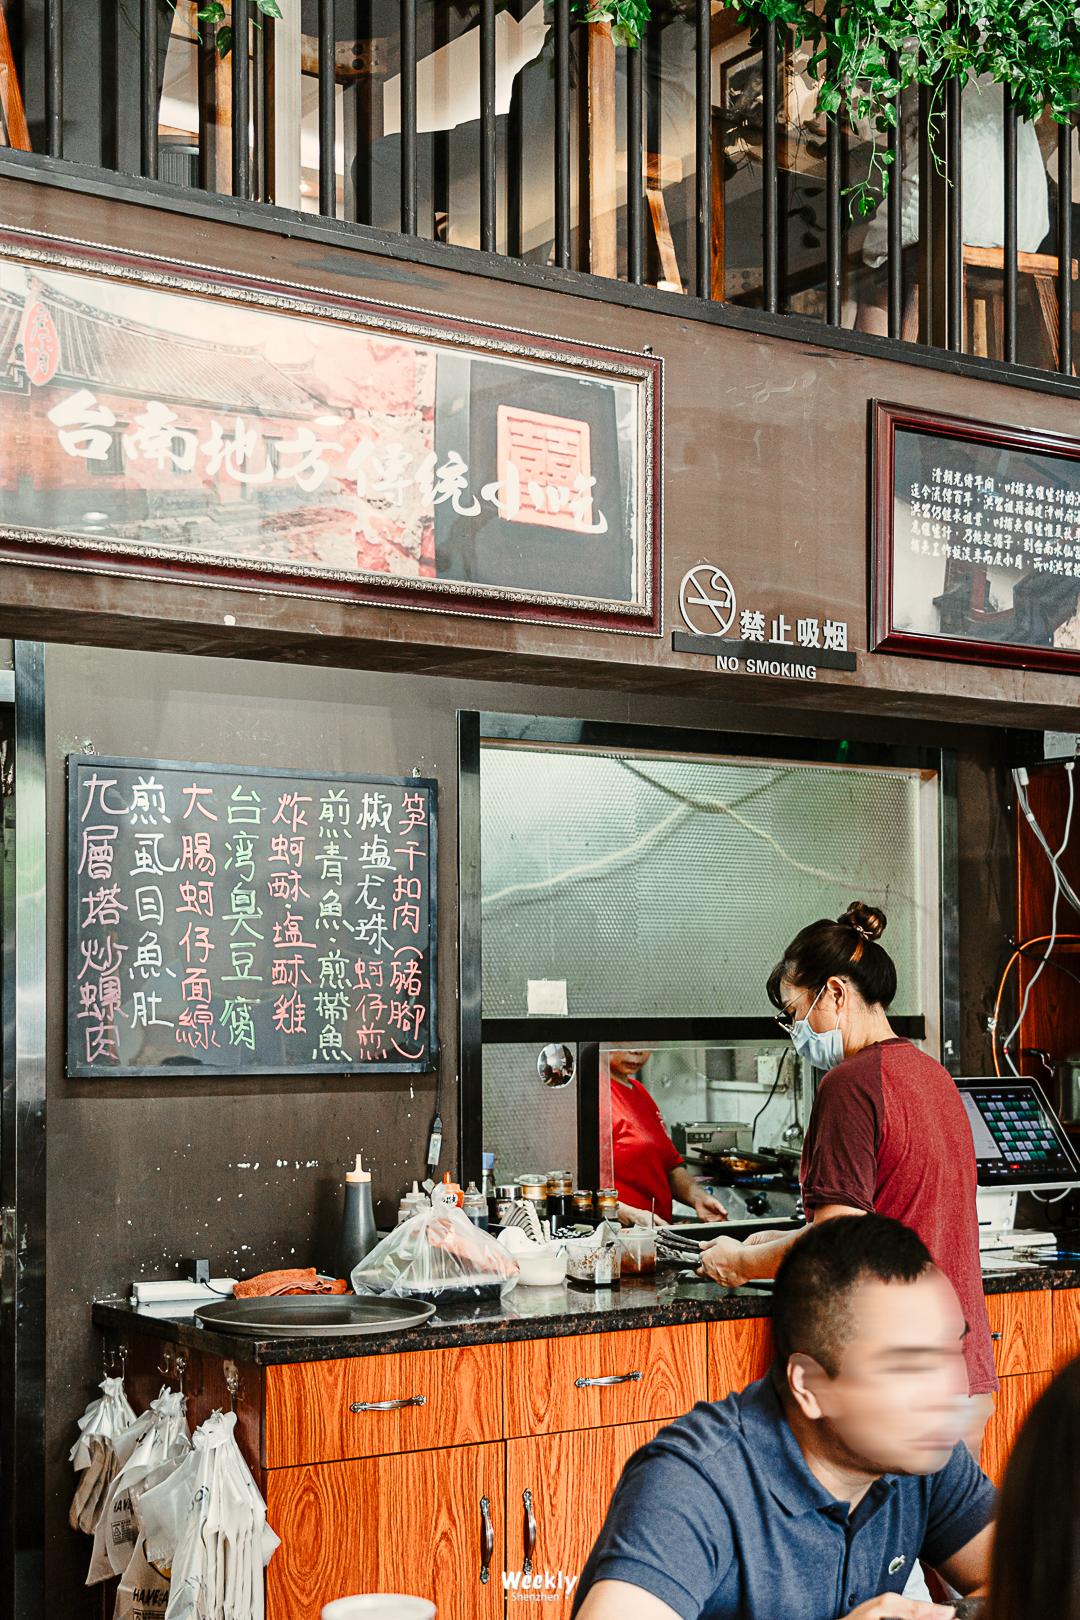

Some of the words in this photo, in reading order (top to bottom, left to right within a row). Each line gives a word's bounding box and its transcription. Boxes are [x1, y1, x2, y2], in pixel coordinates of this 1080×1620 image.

[716, 655, 739, 671] NO
[746, 659, 817, 680] SMOKING
[740, 609, 848, 651] 禁止吸烟
[77, 773, 128, 1063] 九層塔炒螺肉
[129, 775, 180, 1030] 煎虱目魚肚
[175, 783, 221, 1050] 大腸蚵仔面線
